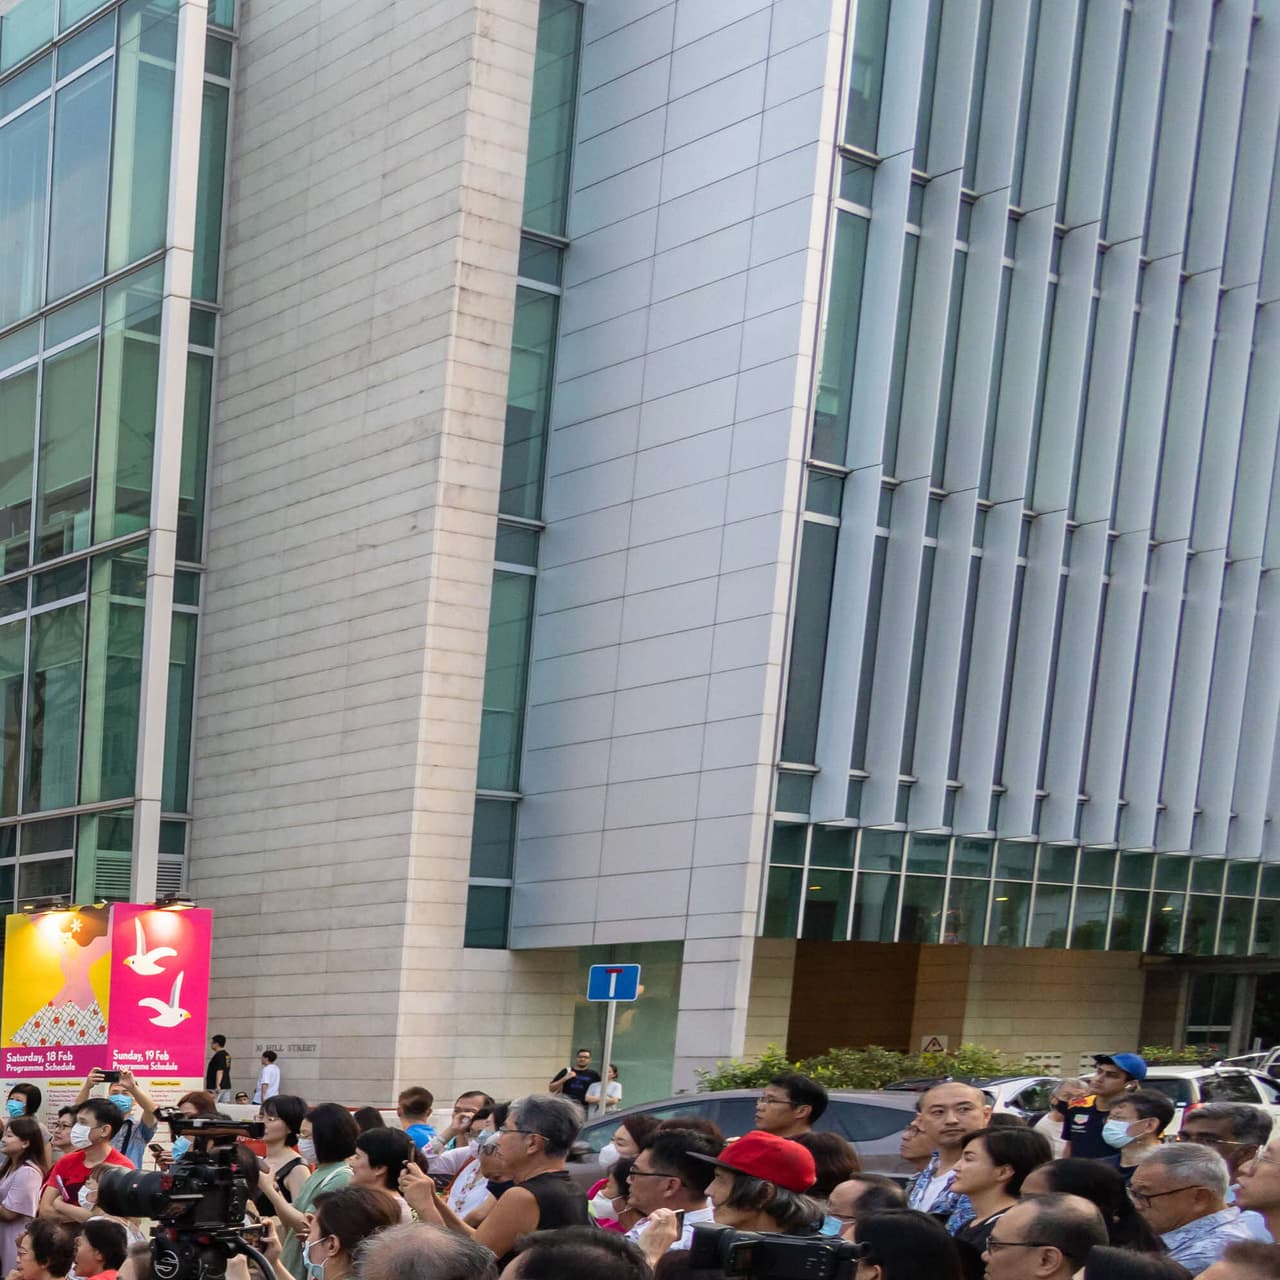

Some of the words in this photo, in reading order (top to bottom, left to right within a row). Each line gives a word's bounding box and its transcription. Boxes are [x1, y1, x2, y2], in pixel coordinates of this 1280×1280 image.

[287, 1044, 317, 1053] STREET
[6, 1052, 44, 1063] Saturday,
[46, 1051, 56, 1061] 18
[58, 1050, 73, 1061] Feb
[113, 1049, 144, 1062] Sunday,
[145, 1050, 154, 1060] 19
[156, 1050, 170, 1060] Feb
[6, 1063, 44, 1073] Programme
[45, 1062, 76, 1071] Schedule
[112, 1062, 149, 1071] Programme
[150, 1062, 178, 1071] Schedule
